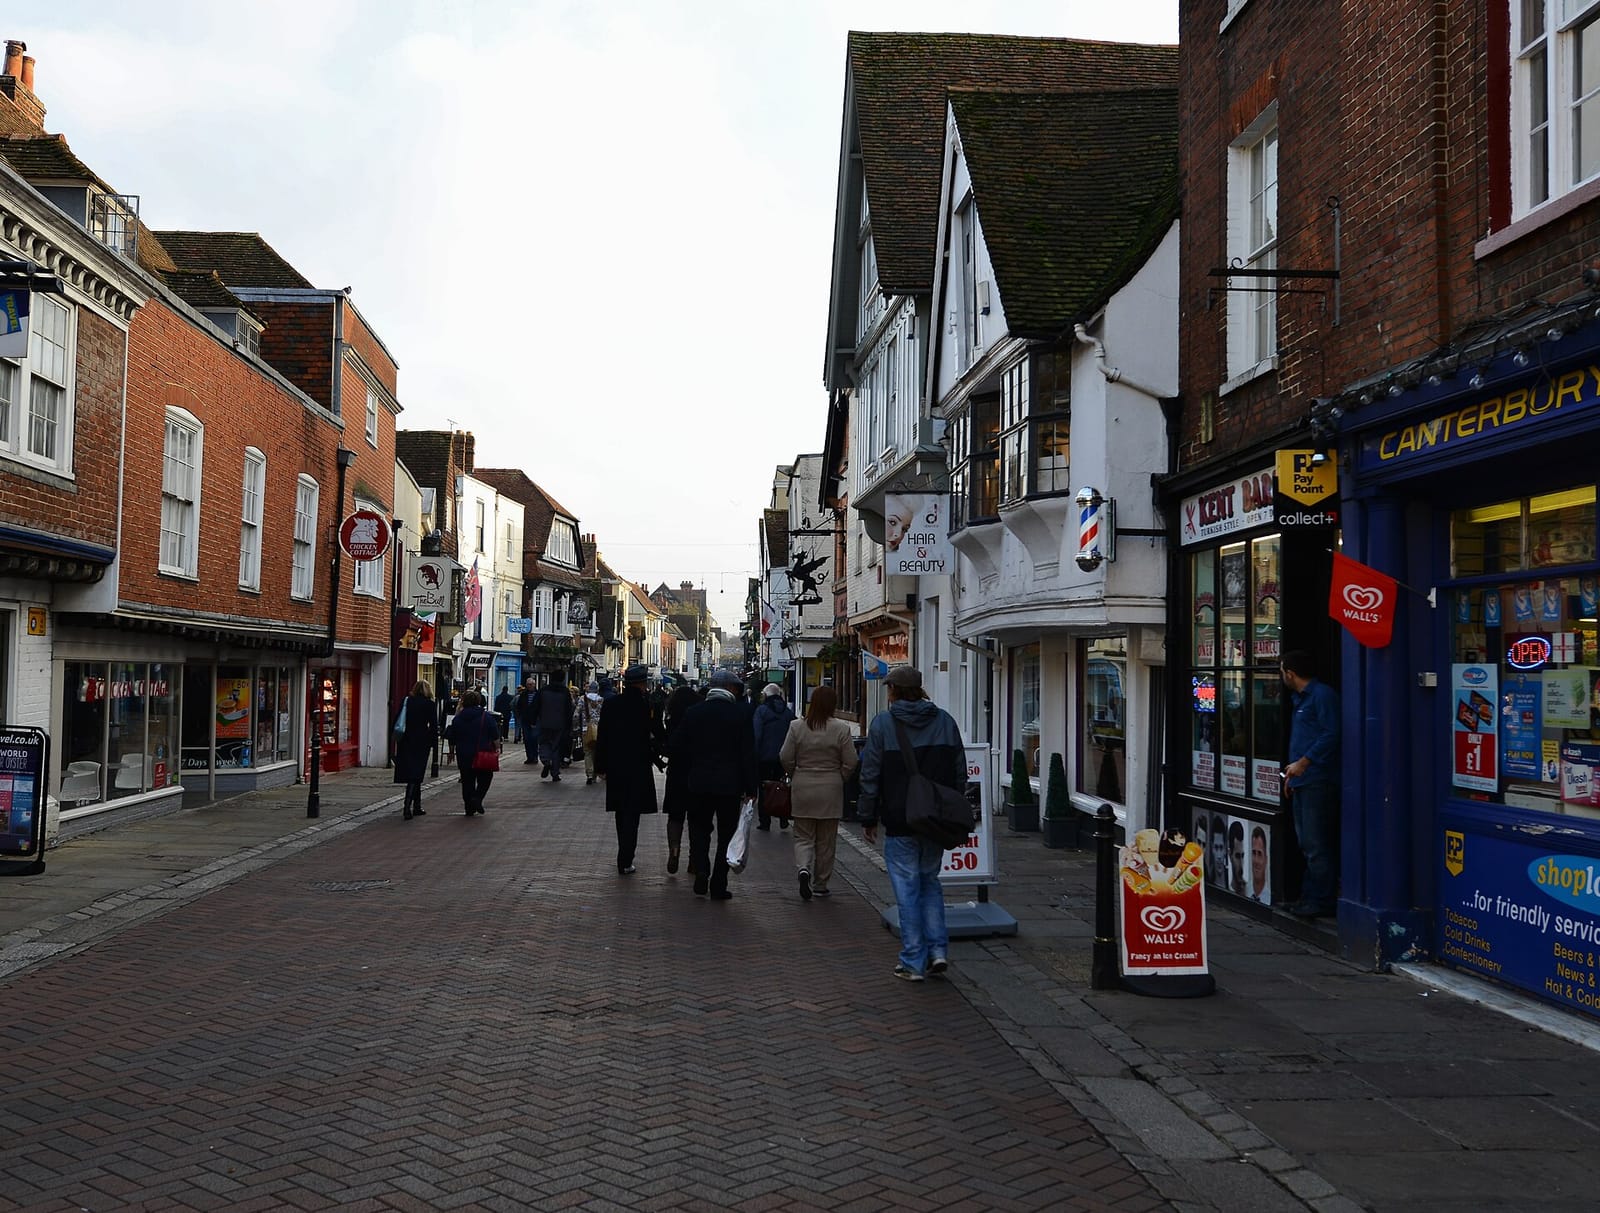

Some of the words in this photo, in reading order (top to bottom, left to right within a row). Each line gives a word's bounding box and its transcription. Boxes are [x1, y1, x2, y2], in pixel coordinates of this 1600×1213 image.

[1379, 363, 1600, 461] CANTERBURY
[1294, 474, 1314, 484] Pay
[1294, 484, 1324, 494] Point
[1199, 485, 1236, 527] KENT
[1201, 523, 1223, 537] TURKISH
[1223, 518, 1240, 532] STYLE
[907, 533, 936, 545] HAIR
[350, 549, 378, 557] COTTAGE
[916, 546, 927, 558] &
[899, 560, 945, 572] BEAUTY
[1343, 608, 1380, 623] WALL'S
[1511, 642, 1549, 664] OPEN
[0, 749, 28, 758] WORLD
[1466, 745, 1482, 772] £1
[187, 759, 208, 769] Days
[1444, 907, 1478, 931] Tobacco
[1496, 895, 1550, 934] friendly
[1144, 933, 1184, 944] WALL'S
[1444, 924, 1462, 943] Cold
[1464, 931, 1492, 954] Drinks
[1130, 951, 1151, 962] Fancy
[1152, 951, 1162, 960] an
[1162, 951, 1173, 960] Ice
[1444, 940, 1502, 974] Confectionery
[1553, 941, 1584, 965] Beers
[1586, 952, 1595, 968] &
[1556, 962, 1585, 984] News
[1587, 972, 1596, 988] &
[1545, 976, 1563, 996] Hot
[1565, 984, 1573, 999] &
